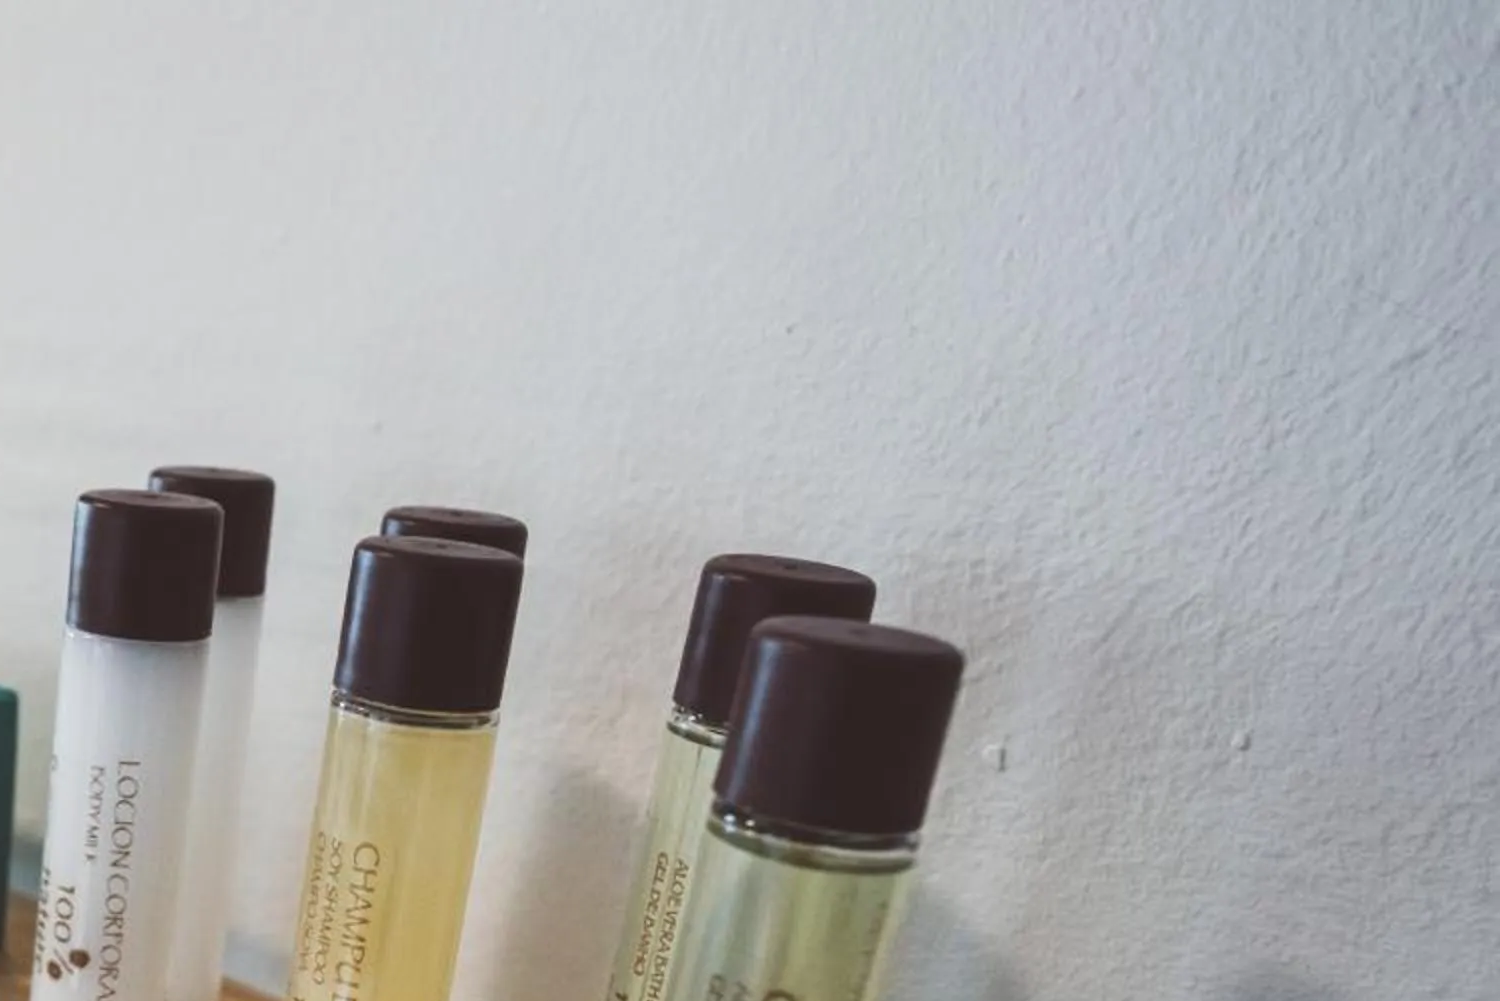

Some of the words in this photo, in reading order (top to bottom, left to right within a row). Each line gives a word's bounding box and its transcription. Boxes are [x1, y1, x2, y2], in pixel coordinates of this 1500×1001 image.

[88, 766, 106, 824] BODY
[327, 837, 343, 880] SOY
[652, 851, 669, 886] GEL
[646, 888, 661, 913] DE
[668, 859, 689, 907] ALOE
[312, 883, 338, 985] SHAMPOO
[657, 911, 679, 953] VERA
[648, 955, 669, 1000] BATH
